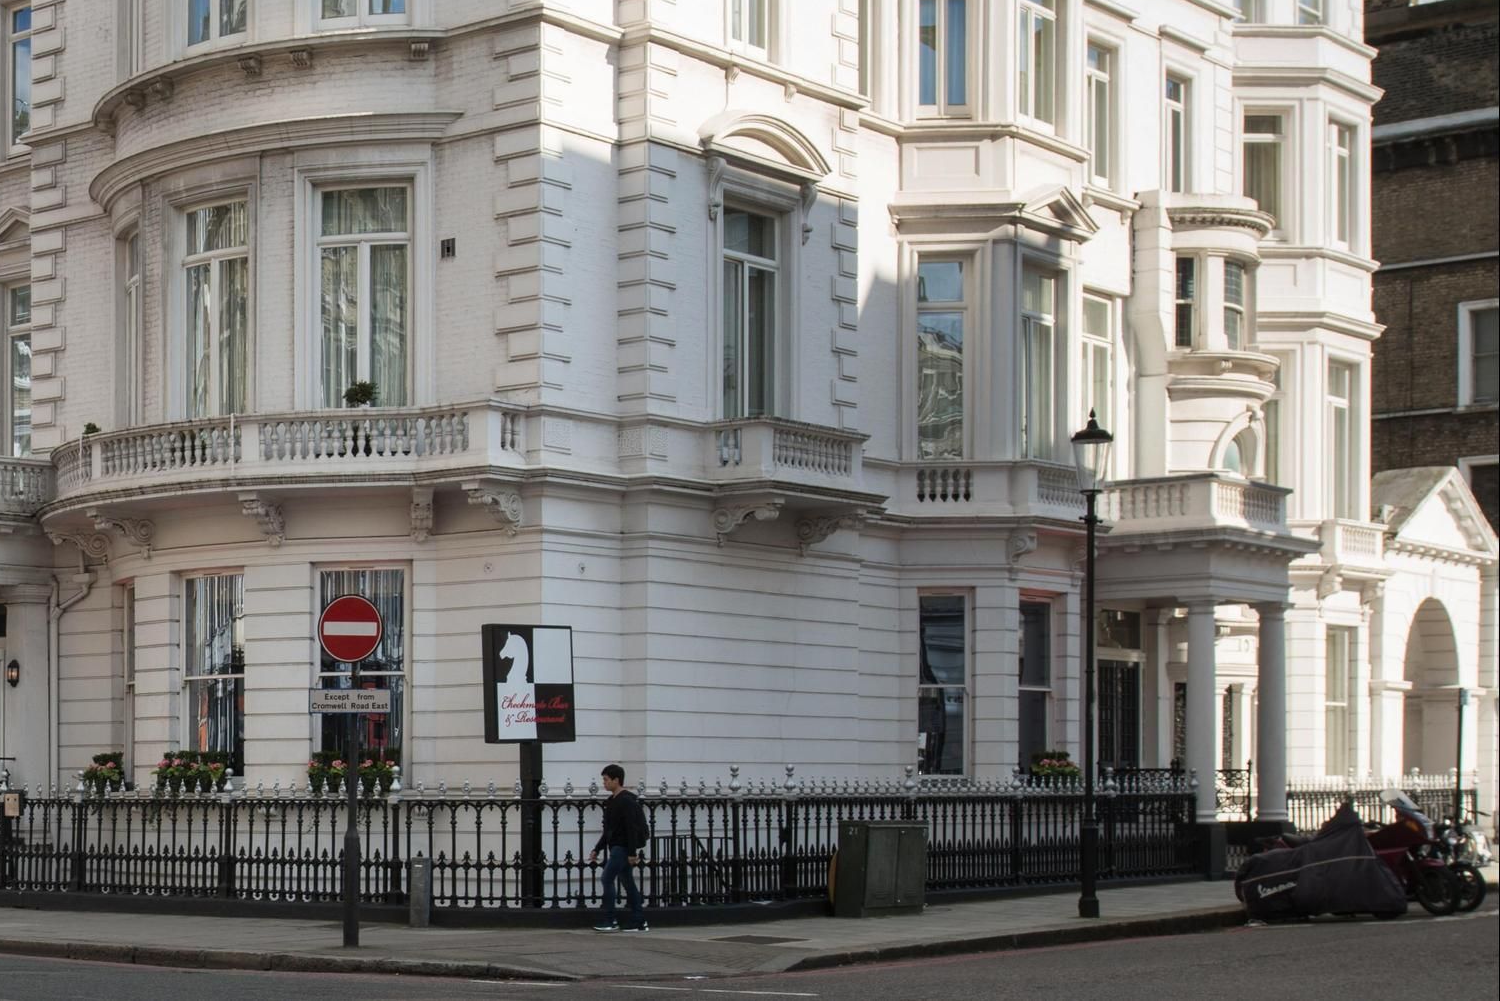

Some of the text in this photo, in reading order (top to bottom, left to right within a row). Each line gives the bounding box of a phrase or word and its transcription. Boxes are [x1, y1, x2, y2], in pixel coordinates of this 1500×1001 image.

[324, 693, 375, 701] Except from
[311, 702, 388, 710] Cromwell Road East
[505, 713, 515, 727] &
